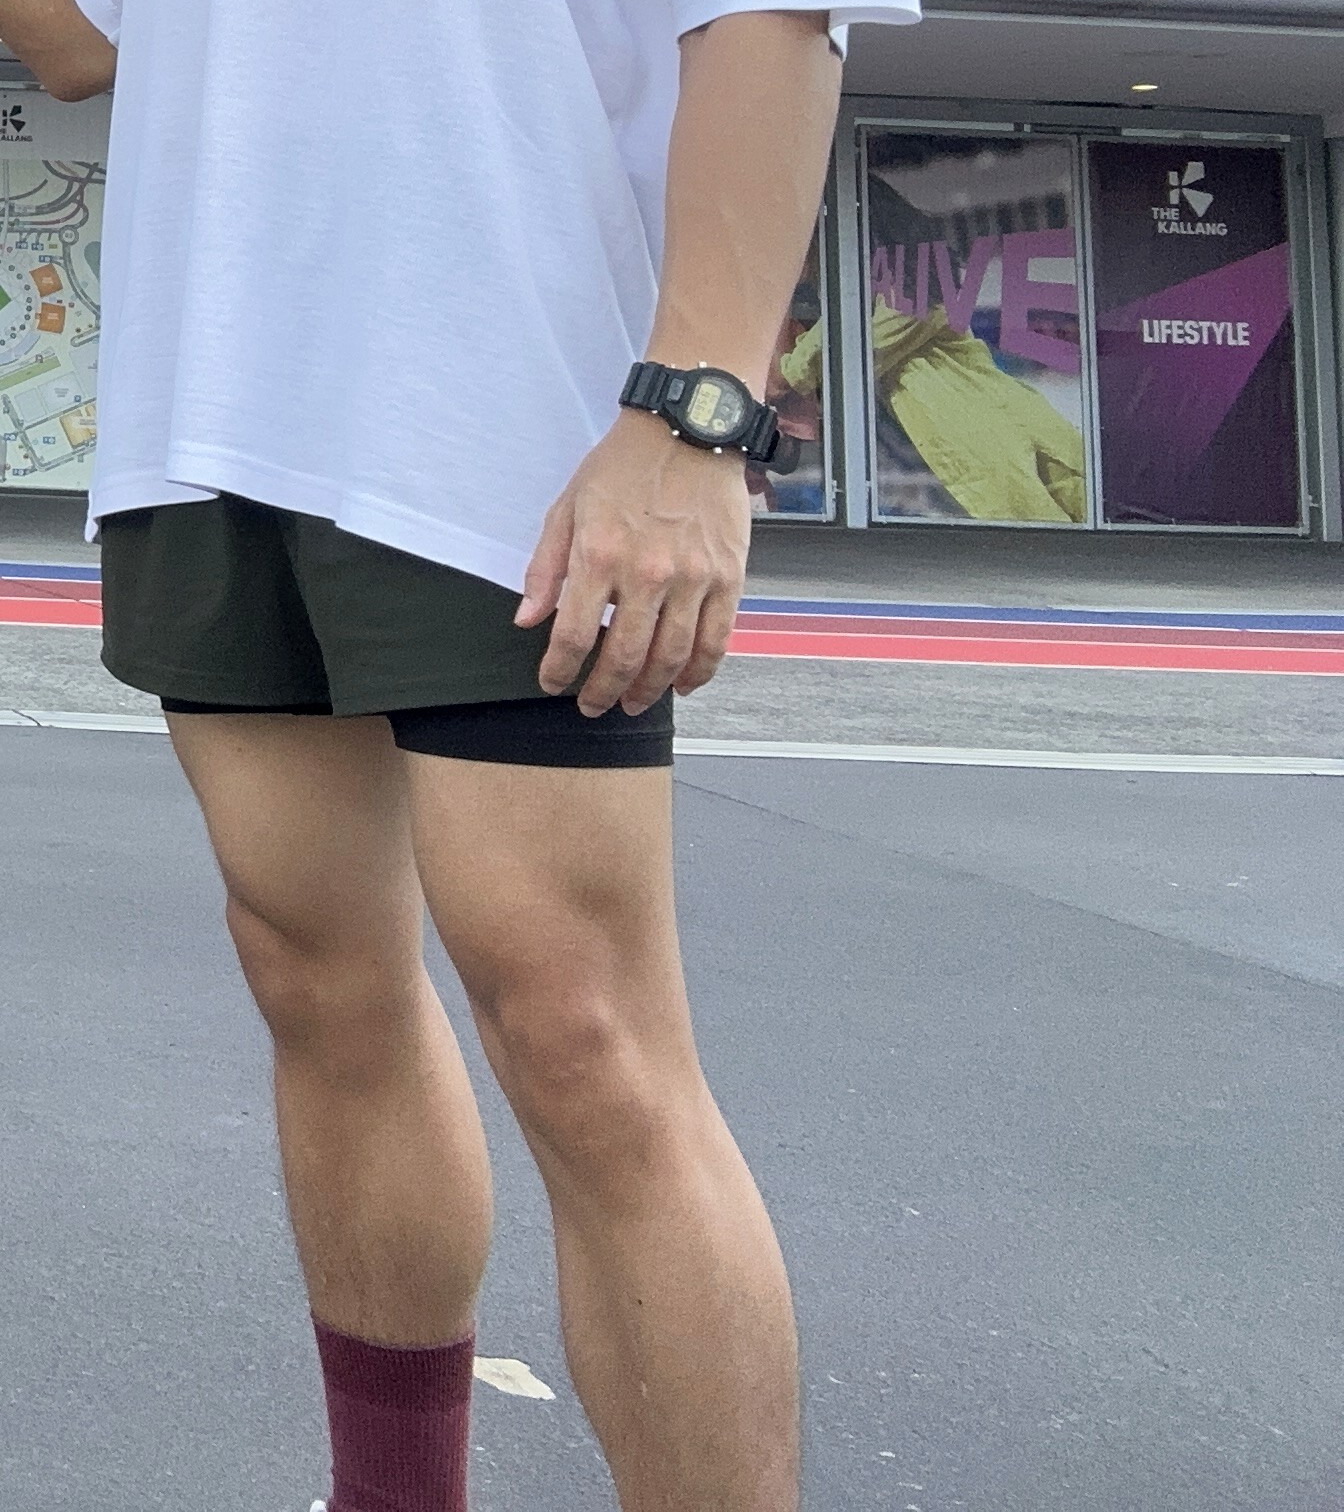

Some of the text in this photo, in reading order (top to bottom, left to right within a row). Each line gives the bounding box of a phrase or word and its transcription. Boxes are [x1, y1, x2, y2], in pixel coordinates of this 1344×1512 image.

[1151, 207, 1179, 220] THE
[1157, 222, 1228, 236] KALLANG
[1141, 319, 1250, 346] LIFESTYLE
